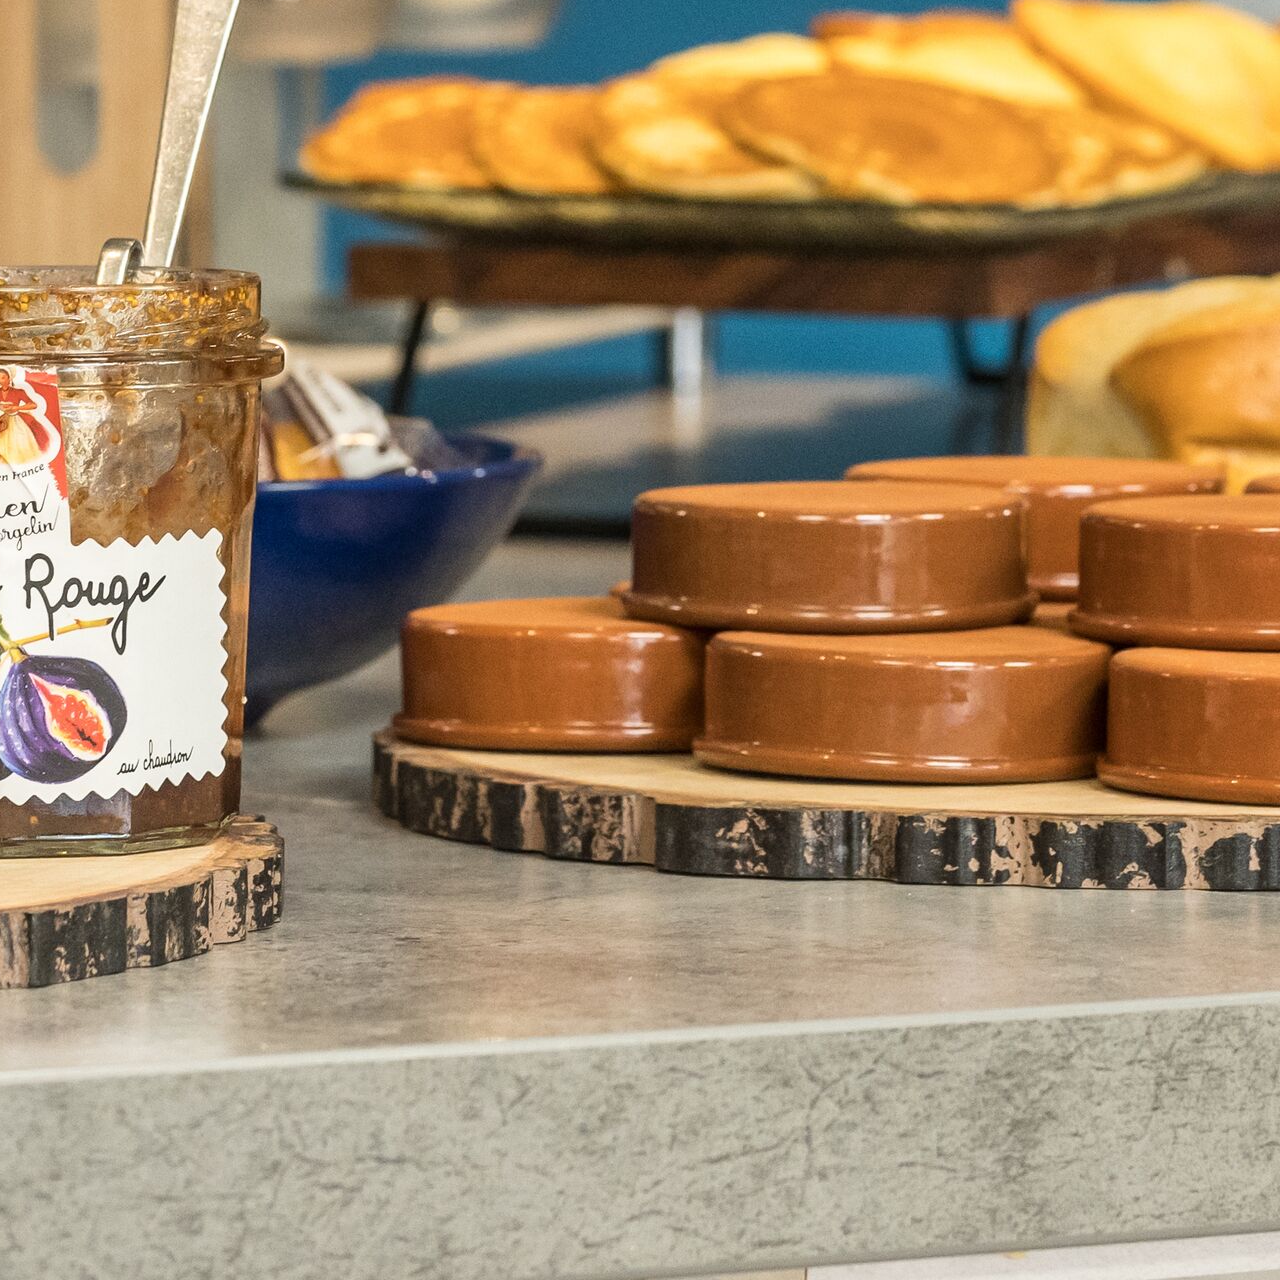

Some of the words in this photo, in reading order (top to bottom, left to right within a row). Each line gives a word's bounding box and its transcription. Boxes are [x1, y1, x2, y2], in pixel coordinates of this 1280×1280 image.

[12, 463, 45, 480] France
[24, 552, 167, 655] Rouge
[116, 758, 141, 776] au
[143, 739, 195, 771] chaudron
